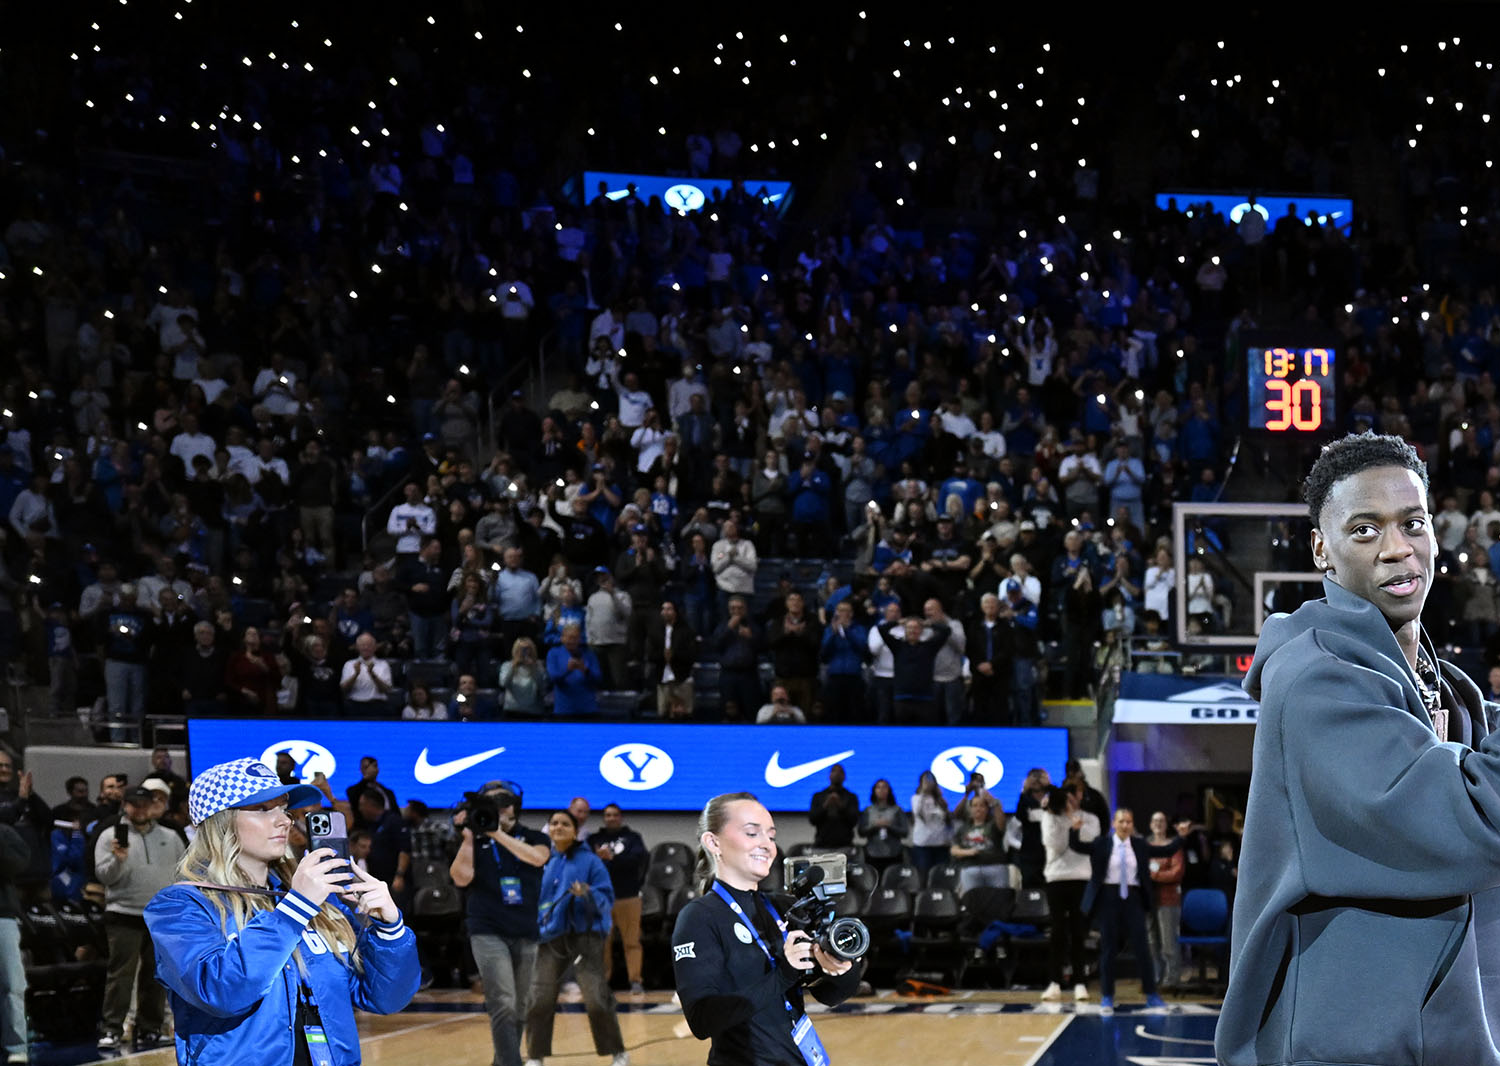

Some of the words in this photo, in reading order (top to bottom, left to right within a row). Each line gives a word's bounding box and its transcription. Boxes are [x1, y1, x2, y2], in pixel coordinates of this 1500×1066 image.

[1264, 348, 1329, 378] 13:17
[1265, 379, 1322, 431] 30
[1190, 707, 1240, 719] GO
[614, 751, 659, 783] Y
